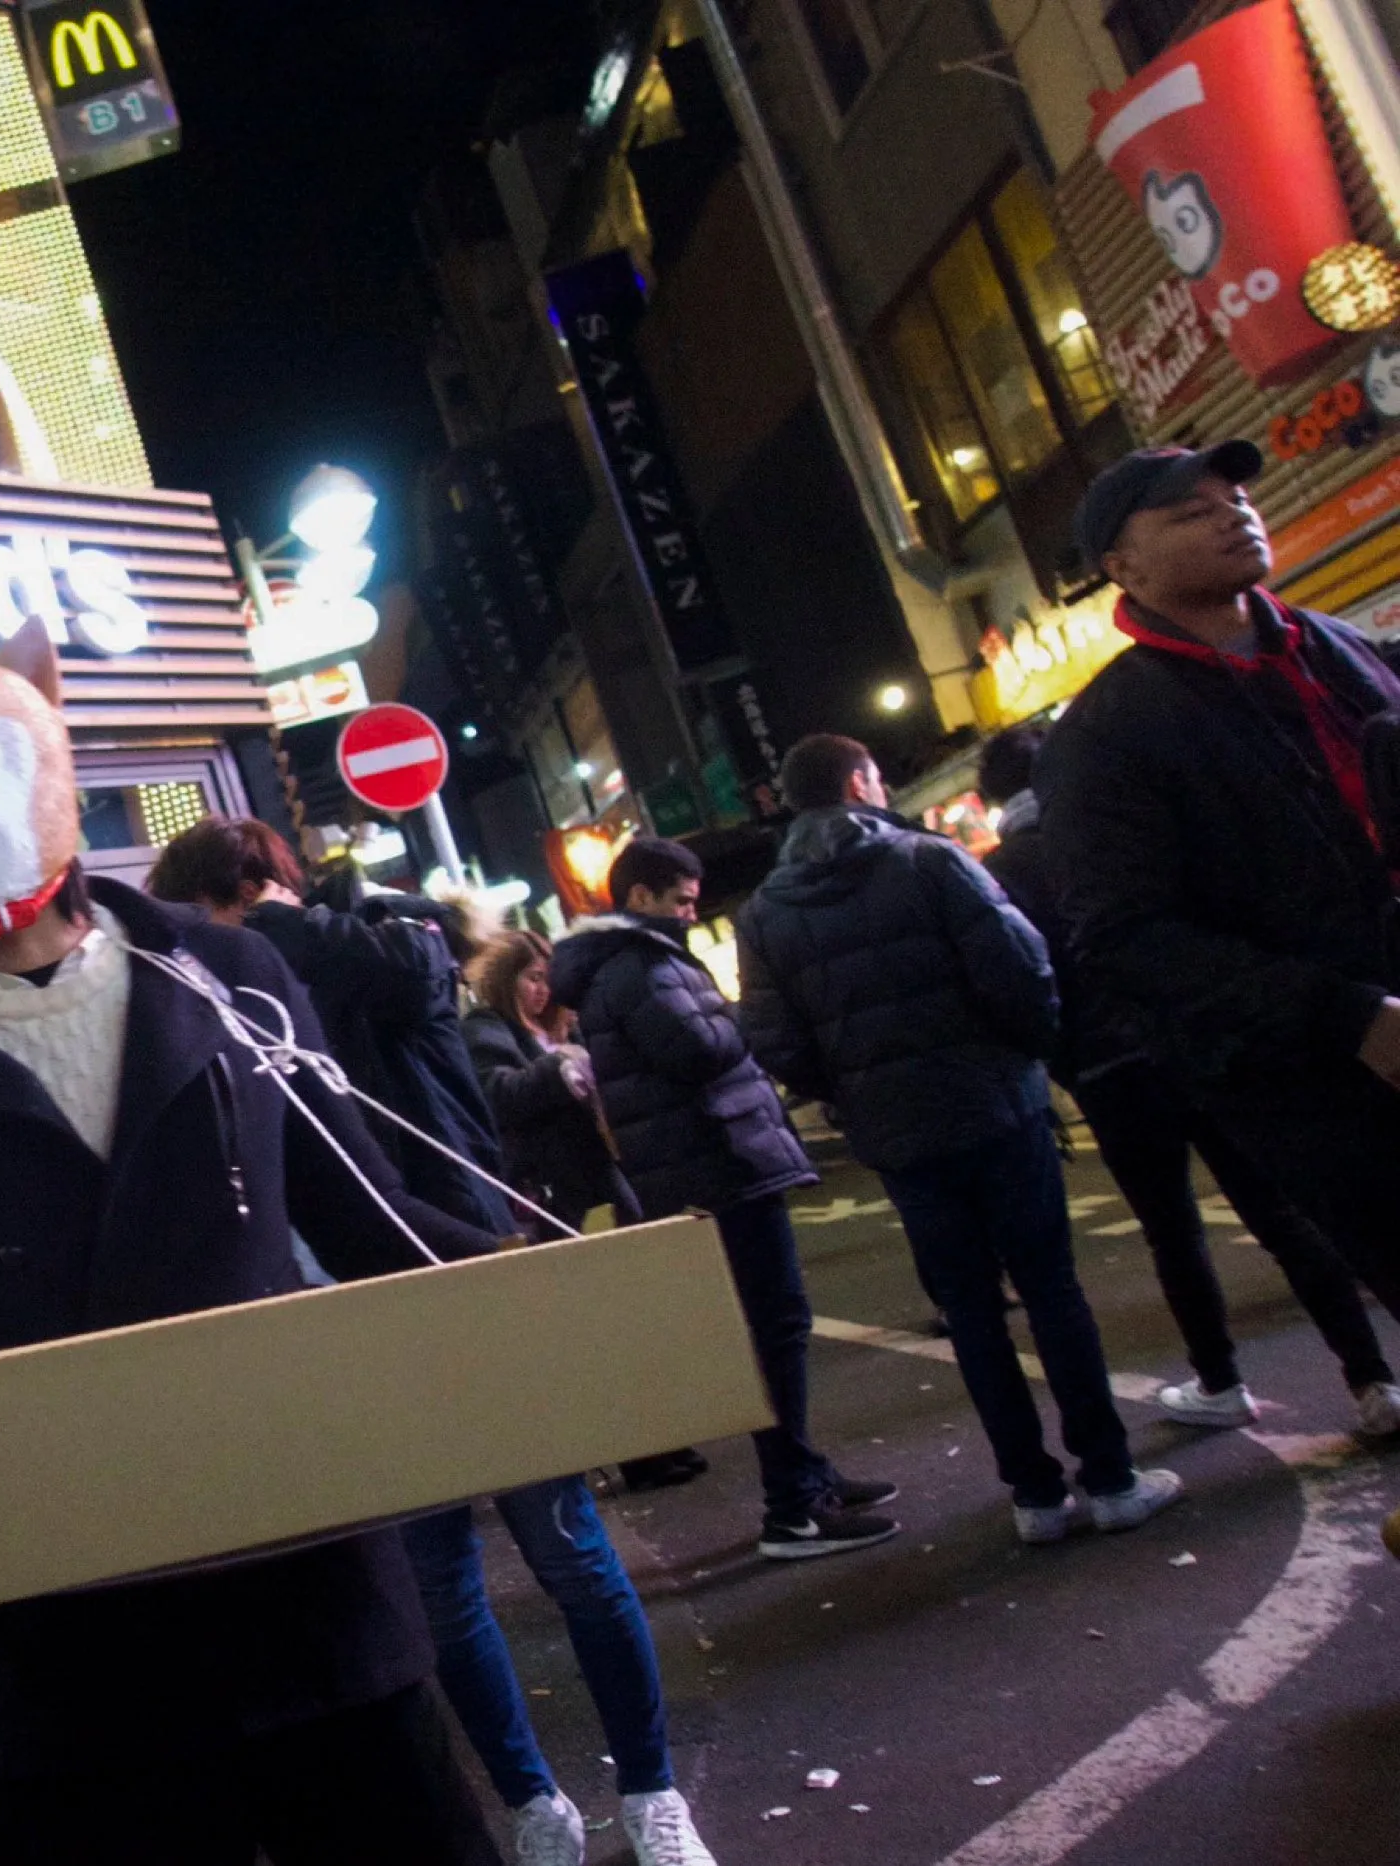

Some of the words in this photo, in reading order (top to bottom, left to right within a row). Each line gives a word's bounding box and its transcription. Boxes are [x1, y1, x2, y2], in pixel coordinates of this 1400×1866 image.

[84, 90, 149, 136] B1
[574, 312, 706, 610] SAKAZEN
[1268, 379, 1363, 461] CoCo
